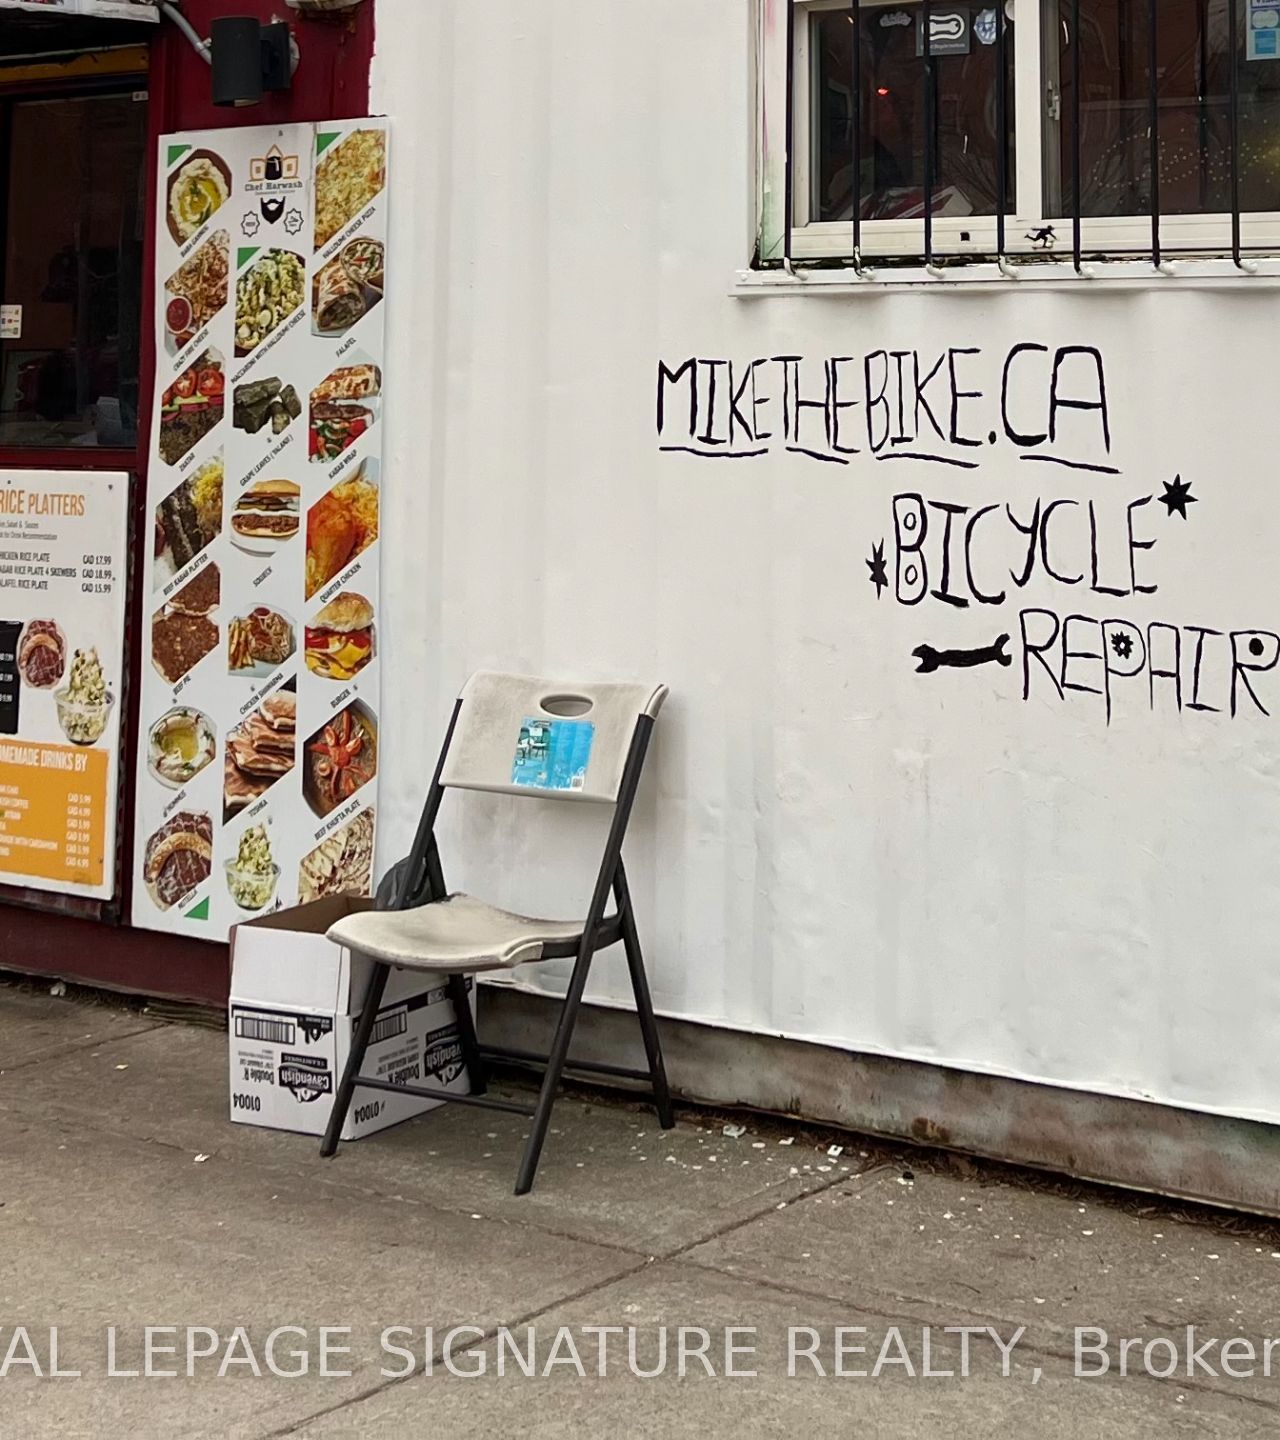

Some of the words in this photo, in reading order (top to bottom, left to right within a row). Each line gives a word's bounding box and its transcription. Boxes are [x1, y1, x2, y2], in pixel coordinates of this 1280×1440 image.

[245, 183, 263, 192] Chef
[29, 493, 85, 516] PLATTERS
[20, 552, 30, 561] RICE
[32, 553, 50, 562] PLATE
[893, 493, 1157, 608] BICYCLE
[14, 566, 25, 575] RICE
[26, 566, 44, 576] PLATE
[18, 580, 30, 589] RICE
[31, 581, 48, 590] PLATE
[331, 690, 350, 708] BURGER
[40, 749, 73, 771] DRINKS
[75, 753, 88, 772] BY
[250, 1069, 274, 1084] Double
[281, 1069, 330, 1089] Cavendish
[233, 1093, 261, 1112] 01004
